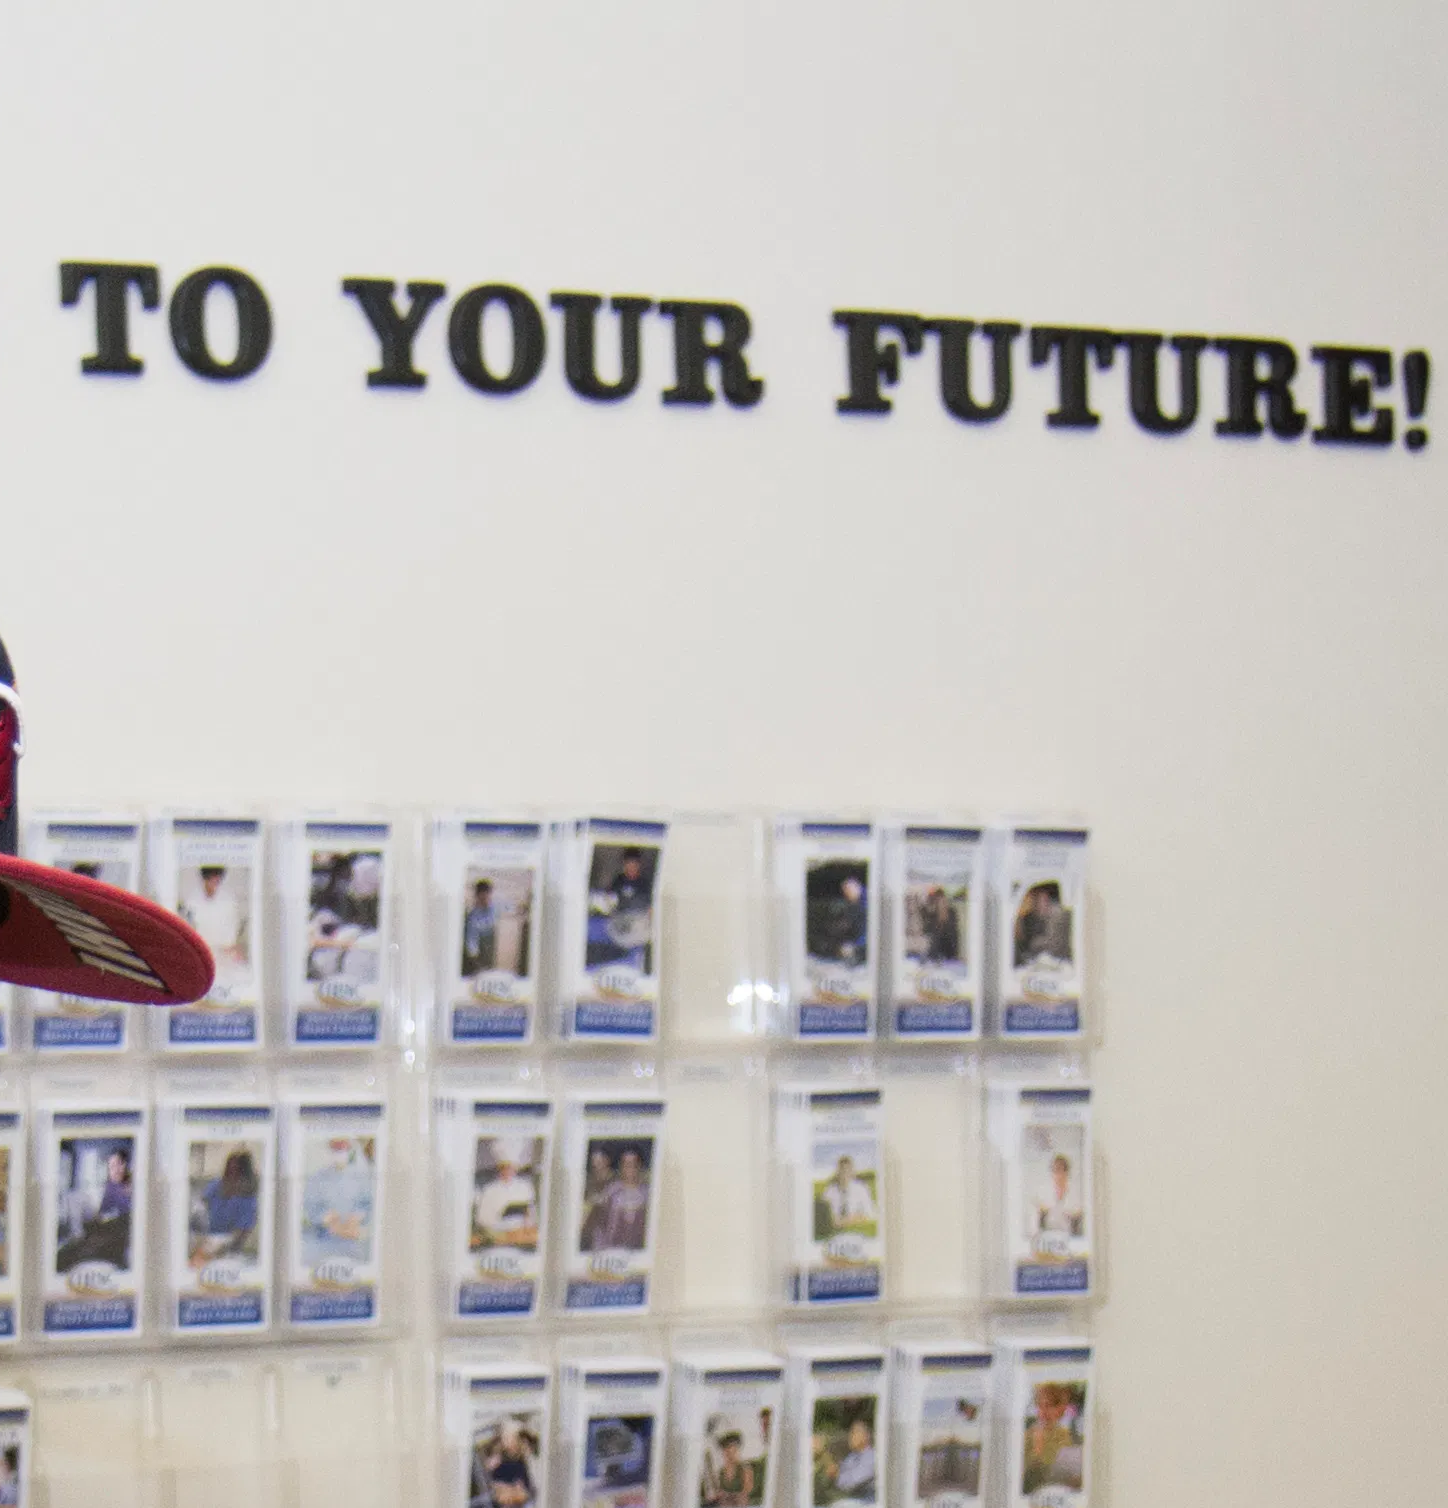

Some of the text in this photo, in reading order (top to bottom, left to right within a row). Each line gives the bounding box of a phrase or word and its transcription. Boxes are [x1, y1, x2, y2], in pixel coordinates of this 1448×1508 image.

[59, 262, 273, 384] TO
[342, 278, 764, 410] YOUR
[832, 310, 1431, 454] FUTURE!
